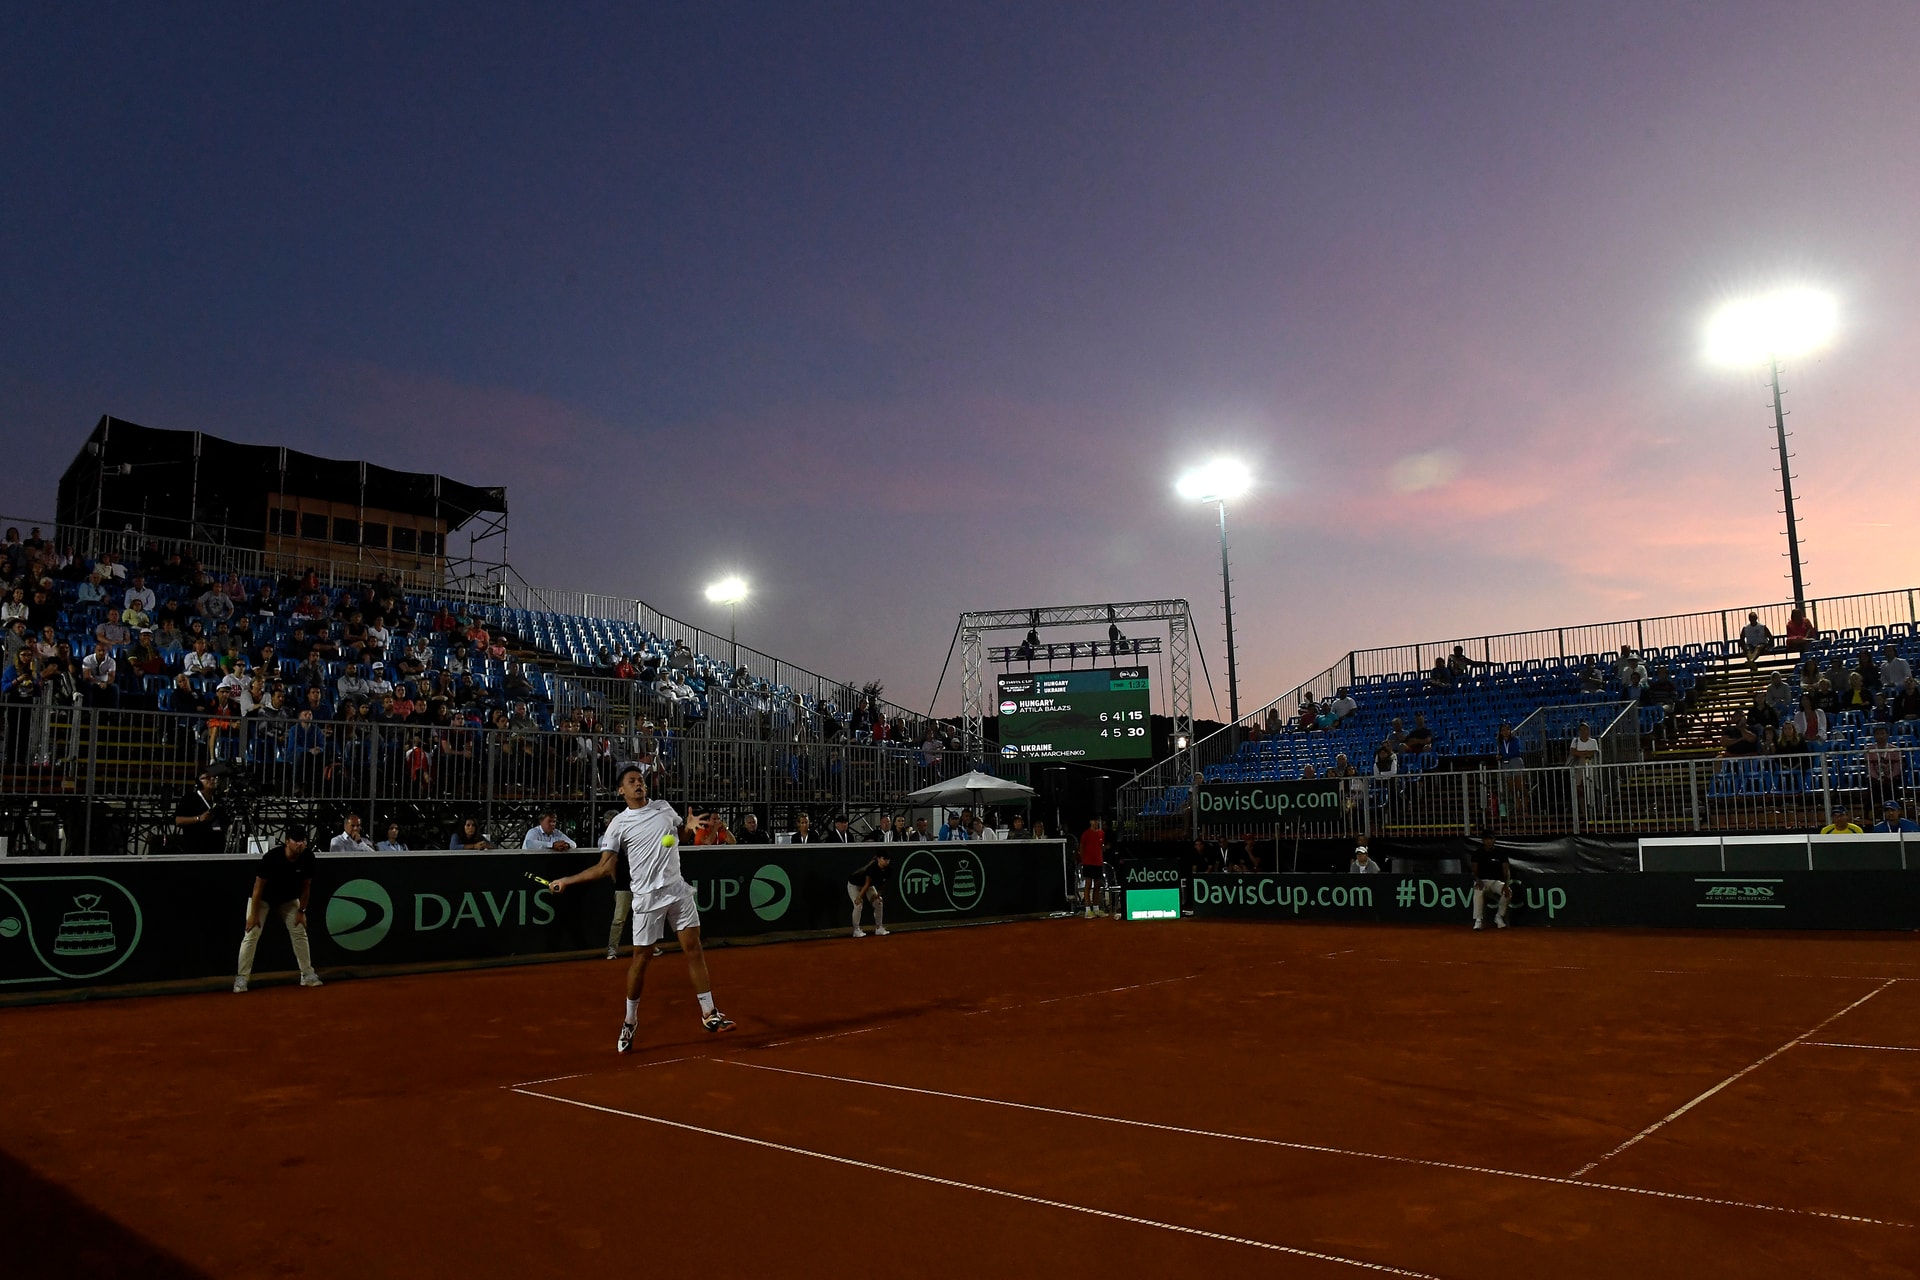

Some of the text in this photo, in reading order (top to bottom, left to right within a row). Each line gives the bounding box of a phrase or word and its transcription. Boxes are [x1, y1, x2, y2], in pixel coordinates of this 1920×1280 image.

[1019, 699, 1054, 708] HUNGARY
[1099, 711, 1143, 722] 6 4 15
[1100, 727, 1144, 737] 4 5 30
[1020, 744, 1052, 752] UKRAINE
[1200, 789, 1338, 815] DavisCup.com
[1126, 867, 1178, 883] Adecco
[907, 877, 930, 894] ITF
[1193, 877, 1373, 914] DavisCup.com
[414, 887, 556, 932] DAVIS
